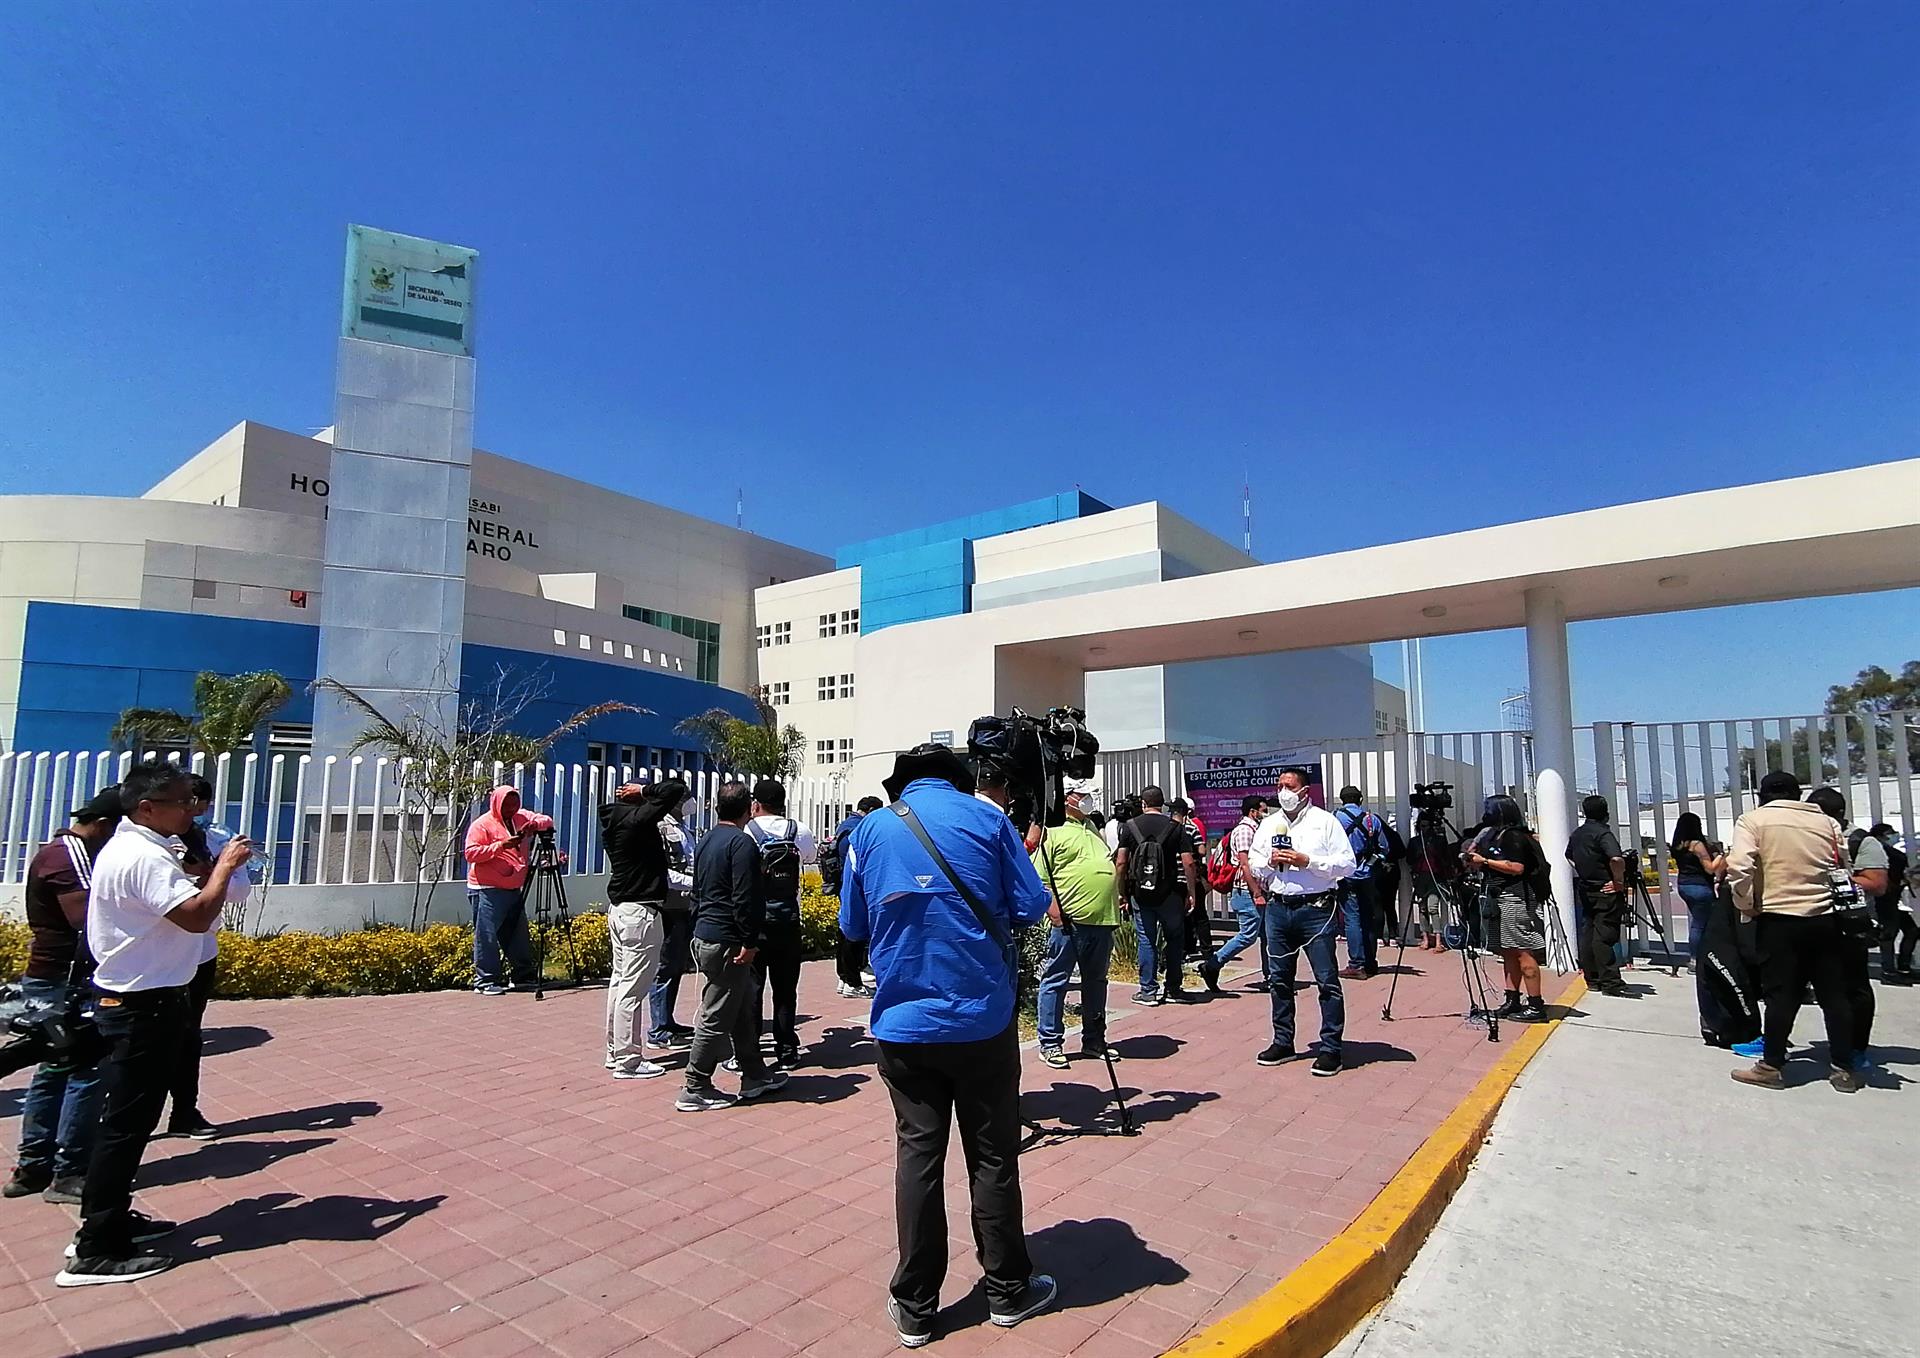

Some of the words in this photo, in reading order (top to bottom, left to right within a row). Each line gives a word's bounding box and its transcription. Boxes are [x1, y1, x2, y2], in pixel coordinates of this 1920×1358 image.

[417, 294, 439, 302] SALUD
[291, 472, 330, 497] HO
[467, 517, 539, 549] NERAL
[466, 538, 512, 561] ARO
[1190, 773, 1208, 781] ESTE
[1210, 769, 1250, 780] HOSPITAL
[1252, 768, 1268, 777] NO
[1205, 779, 1234, 788] CASOS
[1235, 778, 1248, 787] DE
[1707, 951, 1725, 970] United
